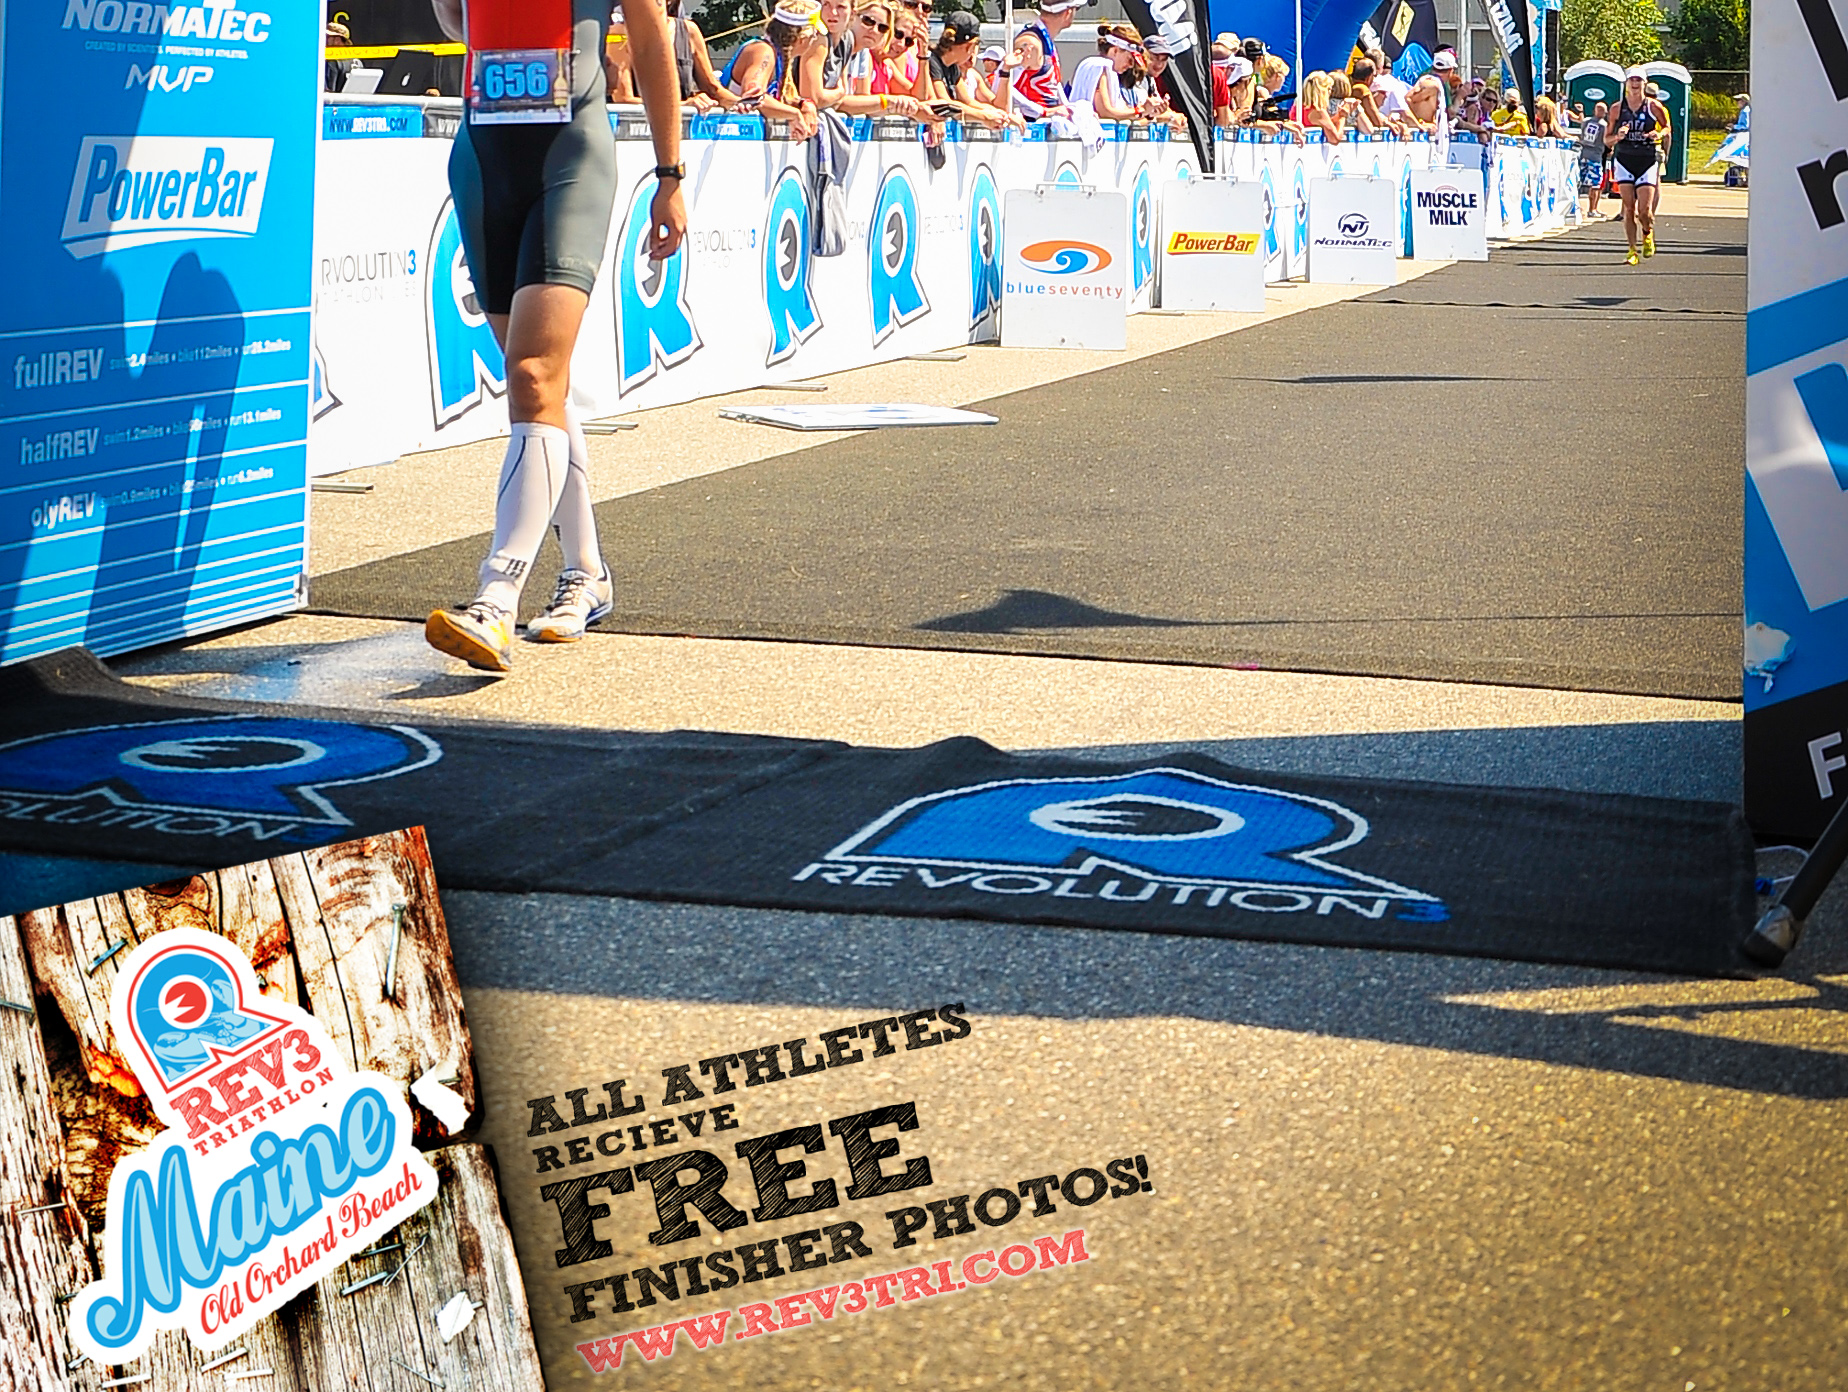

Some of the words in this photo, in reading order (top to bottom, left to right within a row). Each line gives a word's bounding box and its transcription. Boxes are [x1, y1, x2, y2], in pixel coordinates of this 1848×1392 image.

[124, 64, 214, 93] MVP
[485, 61, 549, 99] 656
[78, 144, 258, 224] PowerBar
[1417, 192, 1477, 208] MUSCLE
[1429, 210, 1468, 225] MILK
[1172, 233, 1255, 253] PowerBar
[1006, 281, 1123, 299] blueseventy
[14, 347, 104, 390] fullREV
[20, 428, 99, 465] halfREV
[31, 492, 96, 529] olyREV
